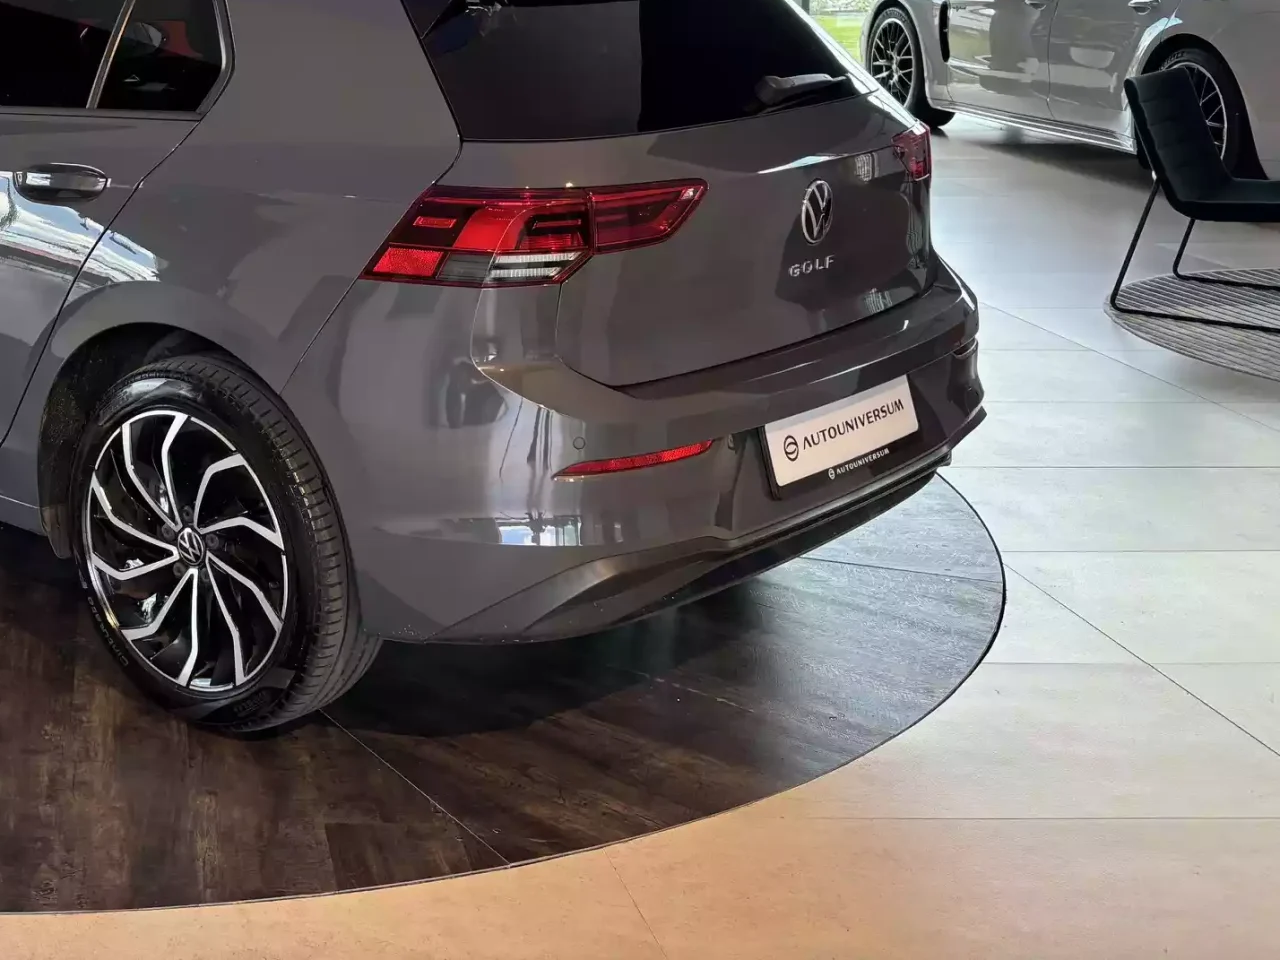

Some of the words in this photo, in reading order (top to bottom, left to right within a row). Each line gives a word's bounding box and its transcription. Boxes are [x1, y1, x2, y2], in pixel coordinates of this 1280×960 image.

[788, 254, 836, 277] GOLF
[803, 398, 904, 450] AUTOUNIVERSUM
[836, 447, 890, 475] AUTOUNIVERSUM
